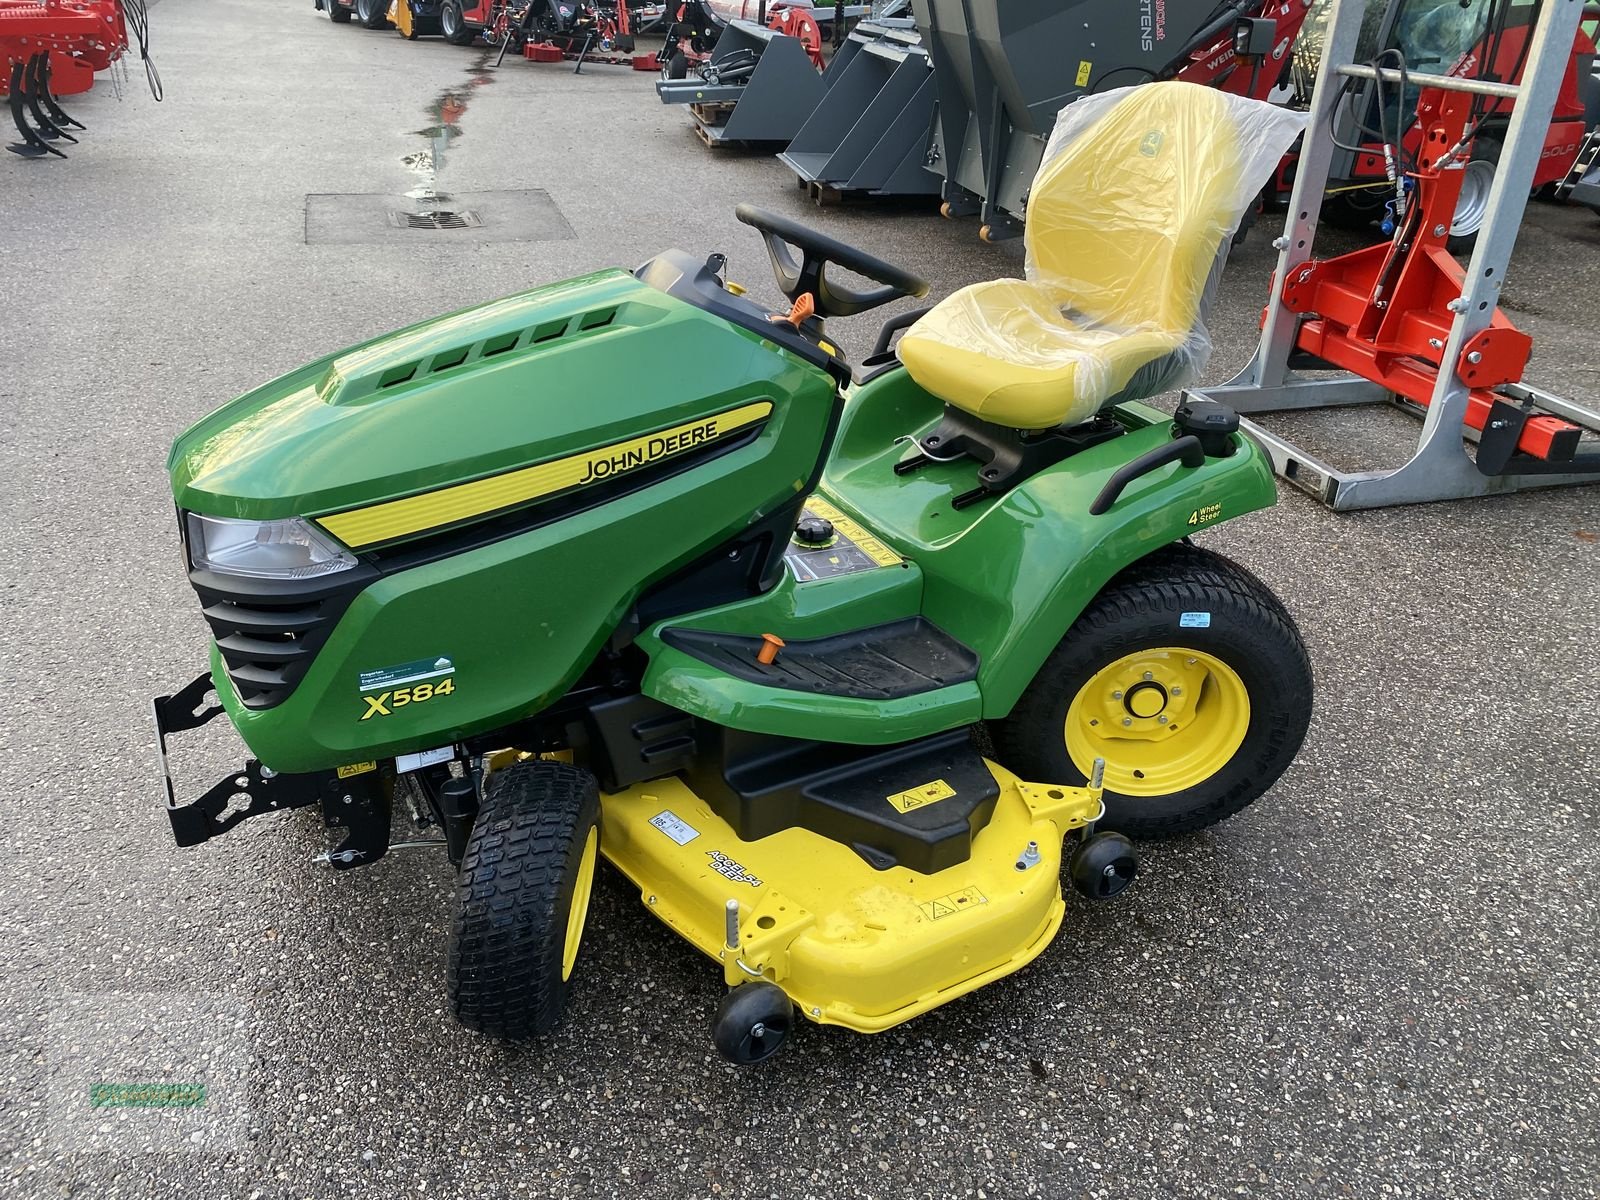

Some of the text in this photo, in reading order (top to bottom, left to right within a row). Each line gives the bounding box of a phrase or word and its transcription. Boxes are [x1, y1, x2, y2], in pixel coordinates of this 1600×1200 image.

[580, 420, 718, 484] JOHN DEERE
[1187, 501, 1222, 525] 4 Wheel
[1199, 510, 1221, 523] Steer
[359, 677, 456, 721] X584
[705, 850, 764, 888] ACCEL 54
[708, 861, 744, 883] DEEP
